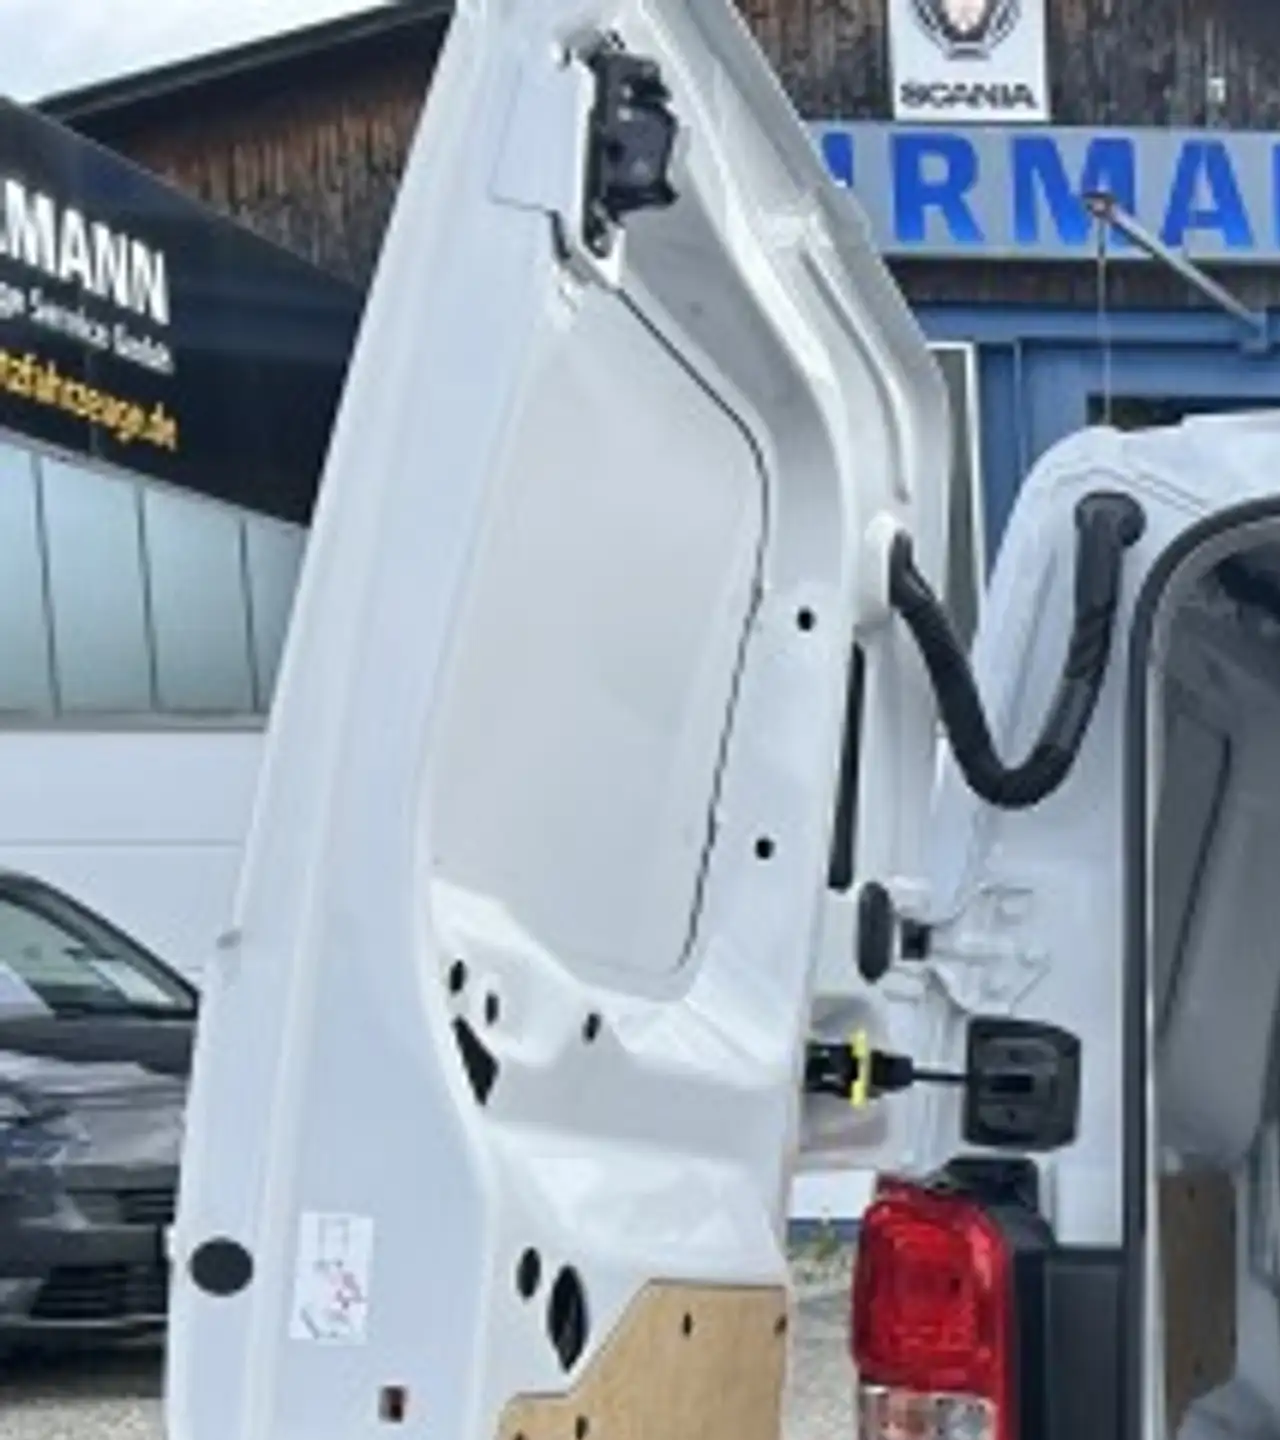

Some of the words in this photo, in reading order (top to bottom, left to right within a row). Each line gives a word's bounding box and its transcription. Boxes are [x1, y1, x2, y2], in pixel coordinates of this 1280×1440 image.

[900, 82, 1037, 109] SCANIA
[0, 178, 170, 326] MANN
[30, 287, 110, 350] Service
